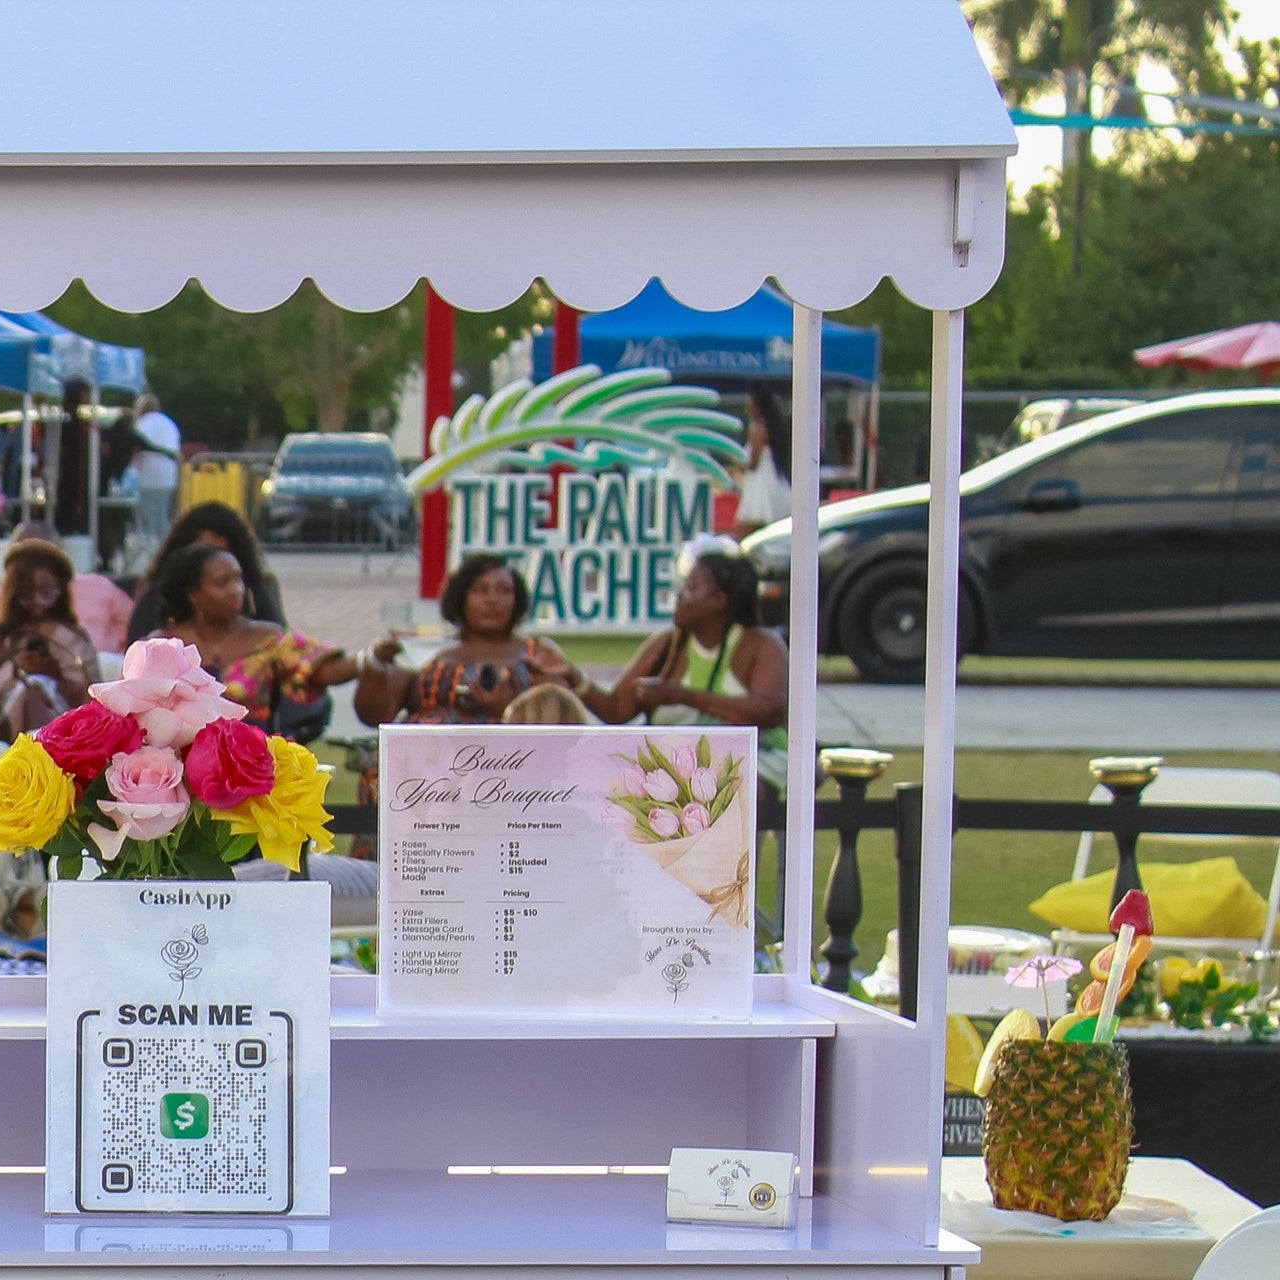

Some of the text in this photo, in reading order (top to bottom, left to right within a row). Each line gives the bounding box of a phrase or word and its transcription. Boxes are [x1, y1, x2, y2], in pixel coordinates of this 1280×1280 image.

[454, 480, 711, 544] THE PALM
[462, 550, 675, 620] ACHE
[448, 744, 536, 772] Build
[389, 776, 579, 813] Your Bouquet
[441, 822, 460, 831] Type
[509, 841, 519, 849] $3
[402, 849, 441, 858] Specialty
[509, 858, 547, 866] Included
[402, 866, 443, 874] Designers
[503, 890, 530, 898] Pricing
[503, 909, 514, 917] $5
[402, 926, 440, 934] Message
[642, 926, 674, 935] Brought
[402, 934, 475, 942] Diamonds/Pearls
[503, 934, 514, 942] $2
[665, 937, 680, 947] De
[402, 950, 421, 959] Light
[503, 950, 517, 958] $15
[402, 967, 433, 975] Folding
[503, 967, 513, 975] $7
[117, 1004, 253, 1026] SCAN ME
